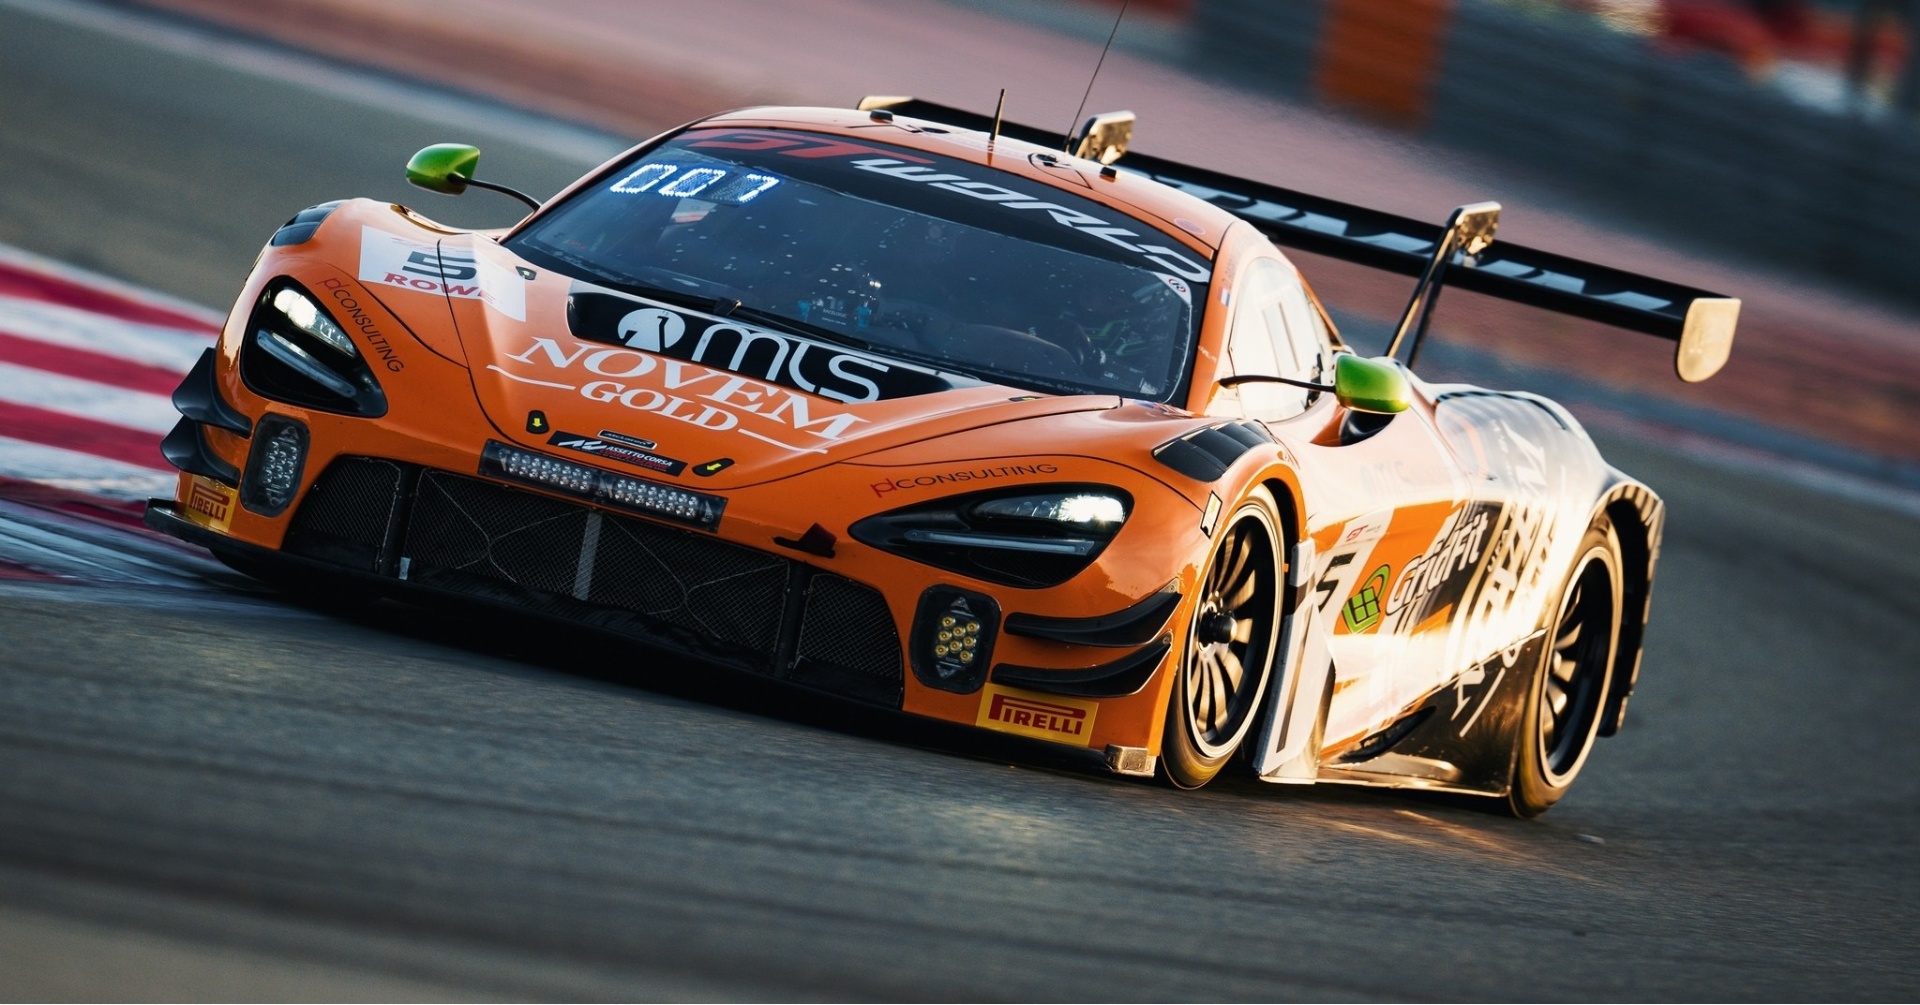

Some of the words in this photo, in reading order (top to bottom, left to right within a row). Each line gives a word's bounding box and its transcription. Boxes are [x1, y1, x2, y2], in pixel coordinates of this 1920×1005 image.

[672, 128, 936, 164] GT
[850, 158, 1212, 283] WORLD
[402, 250, 479, 281] 5
[383, 272, 496, 304] ROWE
[504, 336, 871, 441] NOVEM
[580, 380, 739, 431] GOLD
[605, 445, 646, 459] ASSETTO
[643, 453, 674, 467] CORSA
[189, 482, 231, 522] PIRELLI
[988, 693, 1087, 735] PIRELLI
